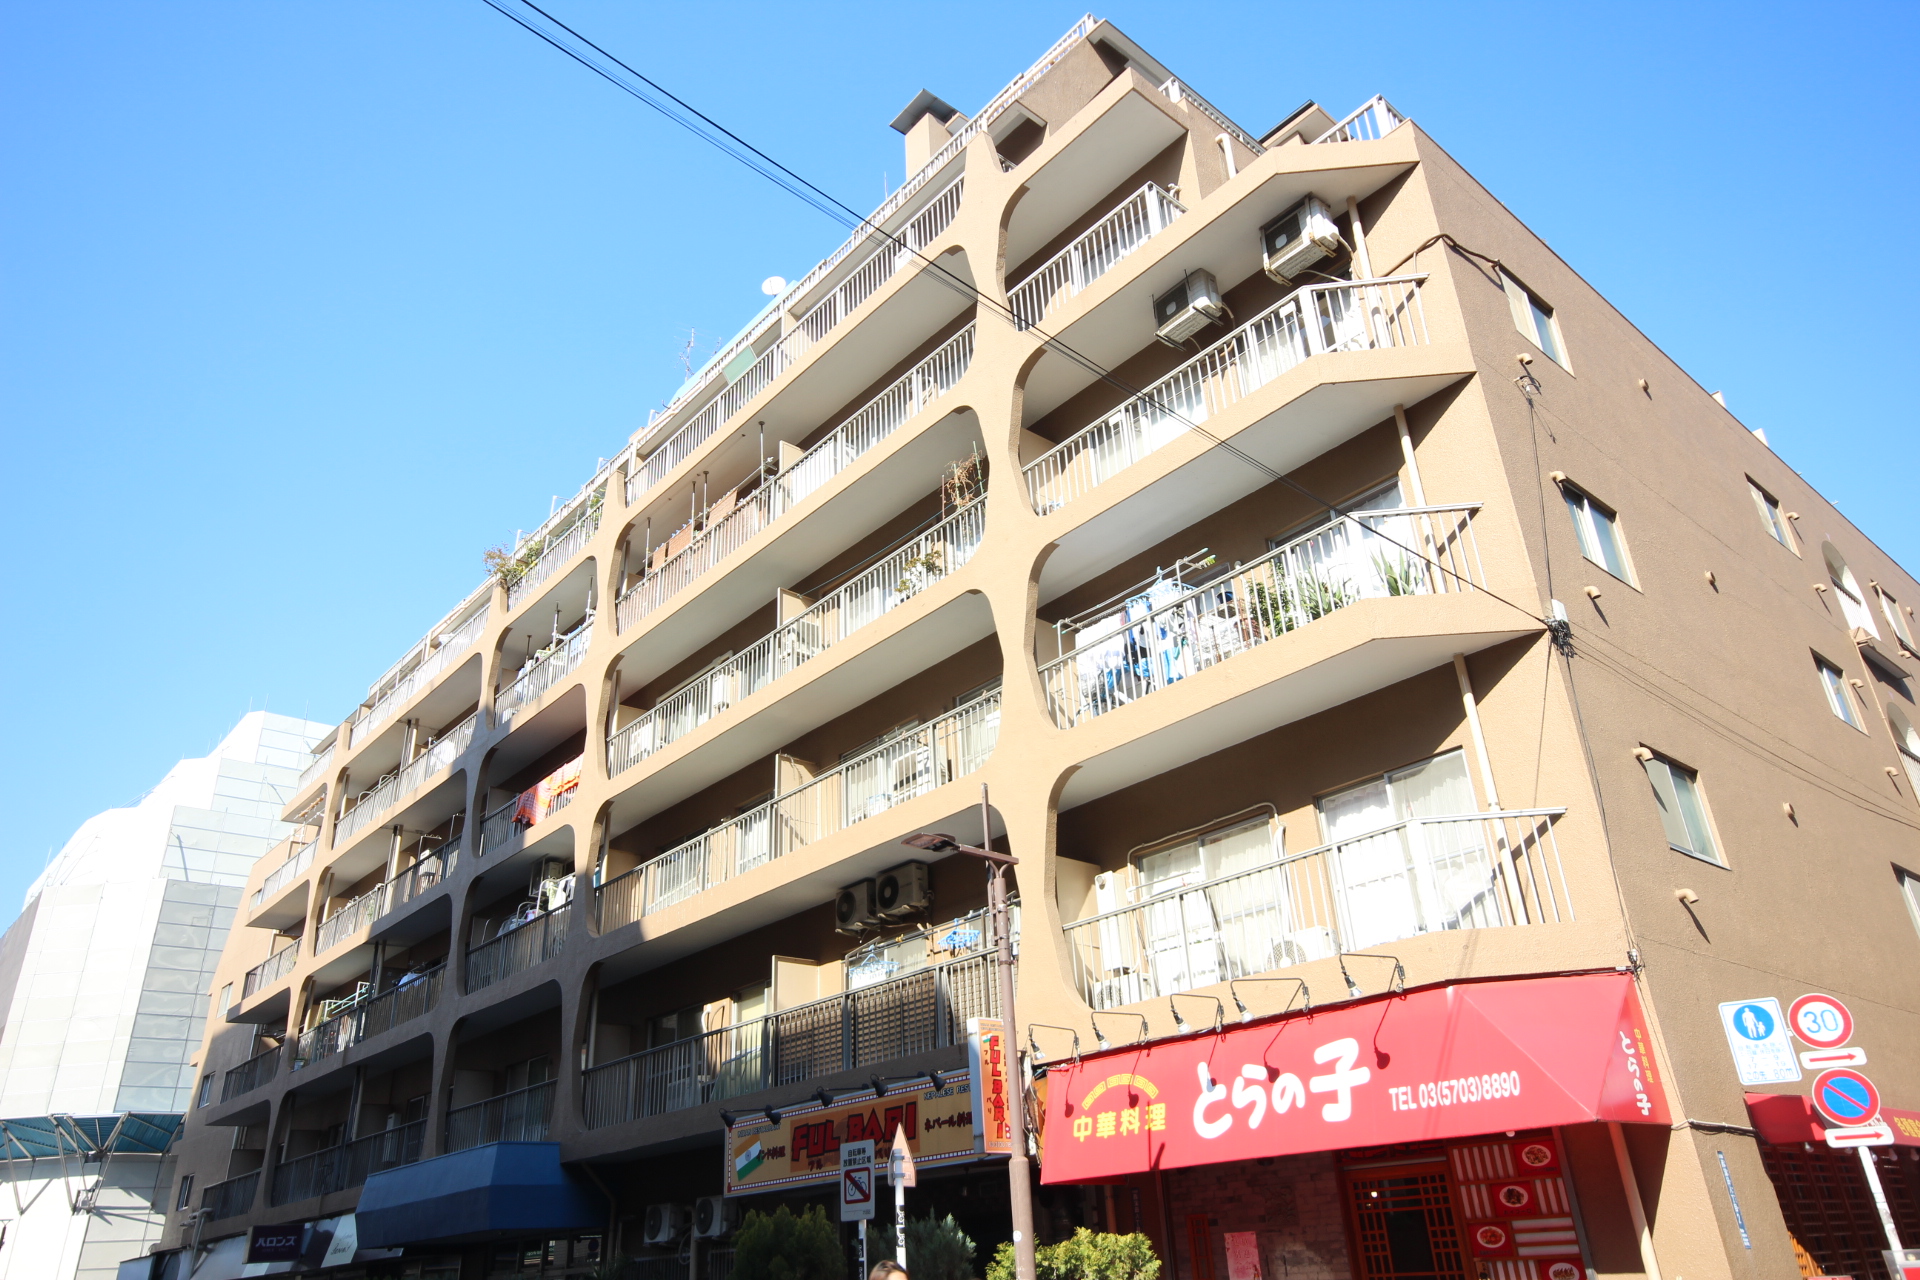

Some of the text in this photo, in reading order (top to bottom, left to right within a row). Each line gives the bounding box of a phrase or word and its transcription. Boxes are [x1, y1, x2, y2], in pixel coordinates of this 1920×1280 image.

[1803, 1009, 1839, 1034] 30
[990, 1035, 1002, 1077] FUL
[1619, 1030, 1652, 1116] とらの子
[1746, 1068, 1794, 1081] この先 80m
[956, 1083, 971, 1094] RES
[992, 1079, 1006, 1139] BARI
[1193, 1037, 1371, 1139] とらの子
[1388, 1070, 1521, 1112] TEL 03(5703)8890
[791, 1101, 917, 1162] FUL BARI
[1073, 1103, 1166, 1143] 中華料理
